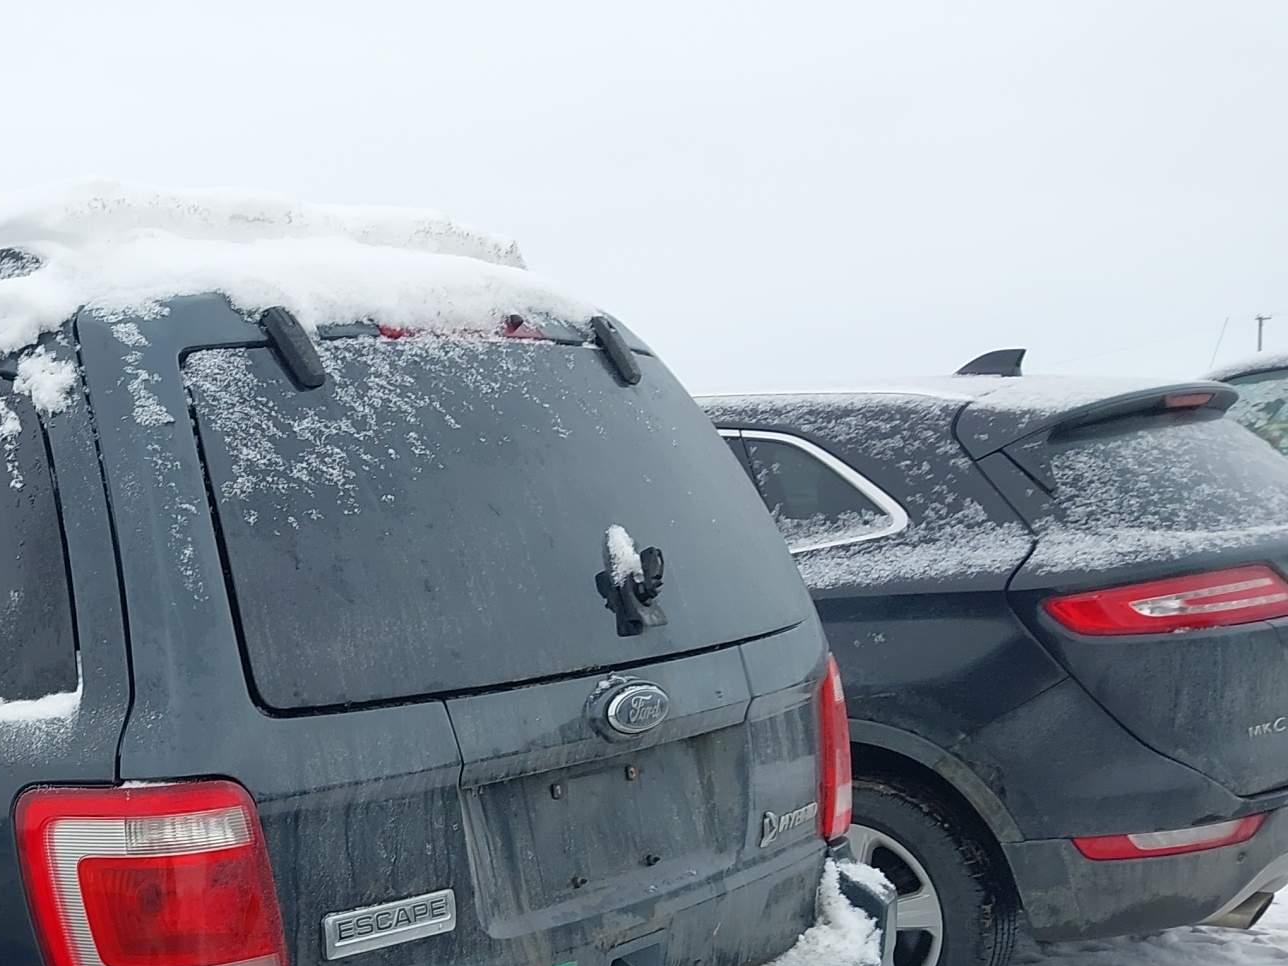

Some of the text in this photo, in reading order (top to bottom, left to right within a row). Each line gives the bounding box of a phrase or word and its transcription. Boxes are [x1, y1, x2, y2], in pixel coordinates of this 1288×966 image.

[629, 694, 661, 722] Ford
[1248, 716, 1287, 737] MKC
[337, 898, 448, 941] ESCAPE
